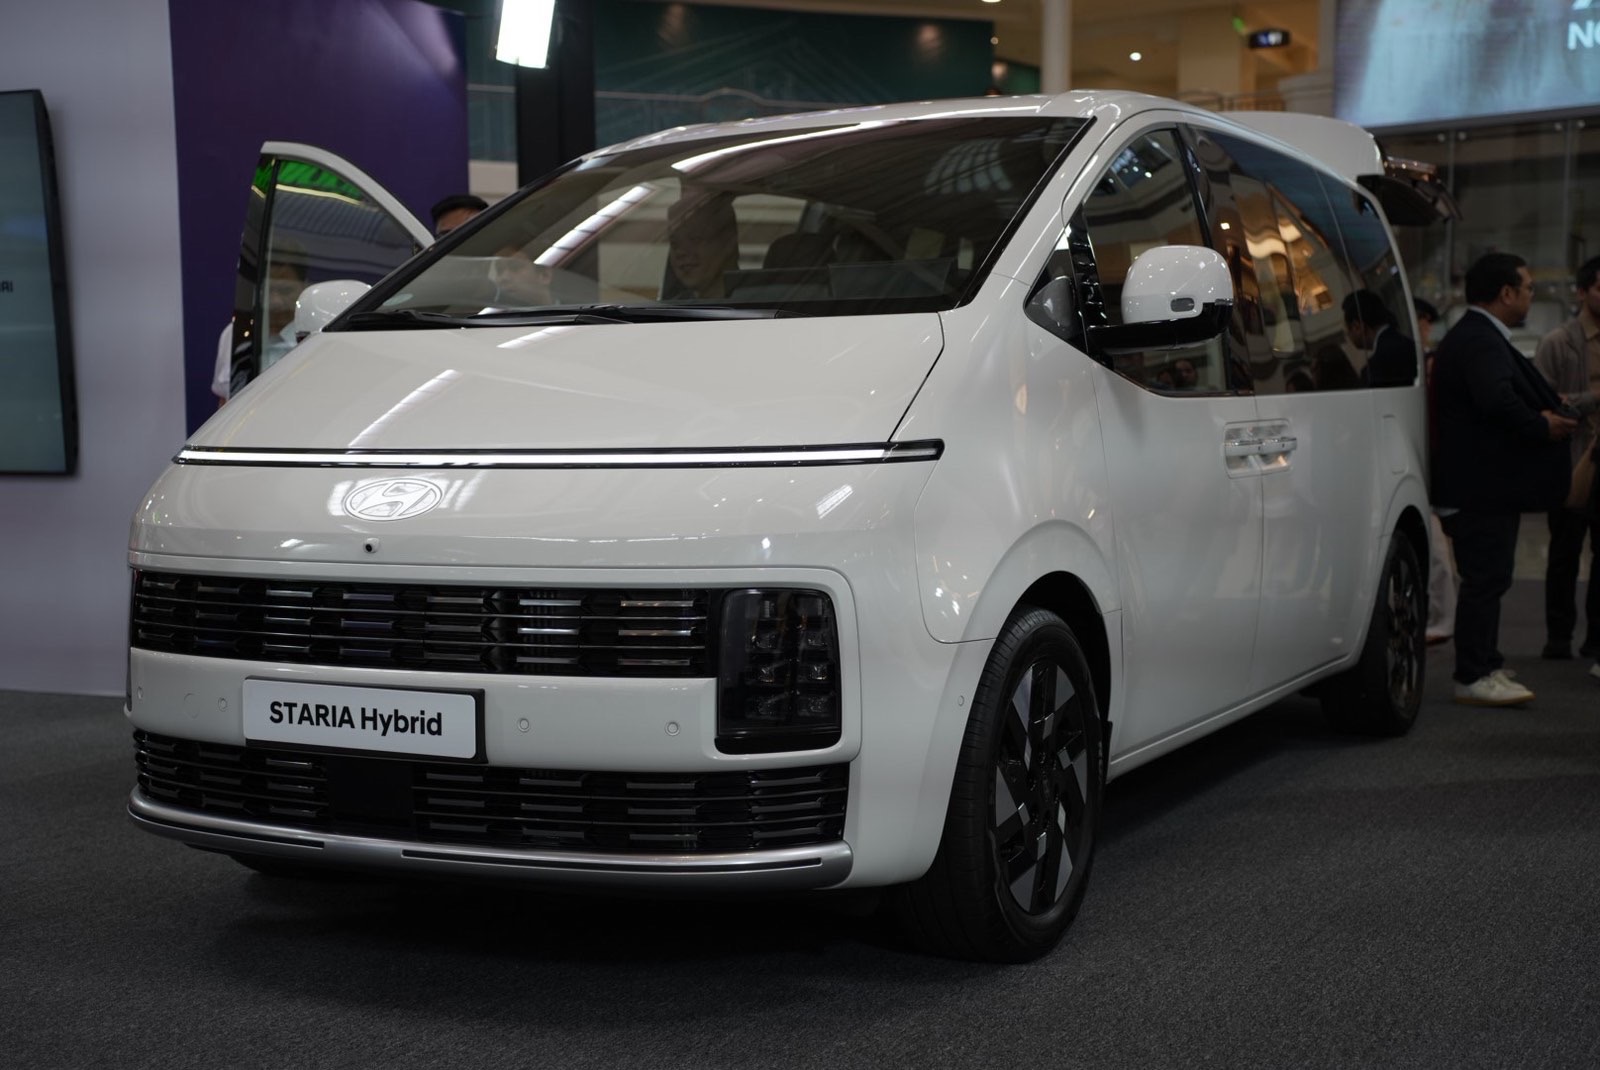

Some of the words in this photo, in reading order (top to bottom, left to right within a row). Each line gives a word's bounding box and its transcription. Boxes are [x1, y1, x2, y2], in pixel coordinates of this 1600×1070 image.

[1567, 20, 1600, 50] N
[269, 700, 356, 729] STARIA
[360, 706, 443, 737] Hybrid
